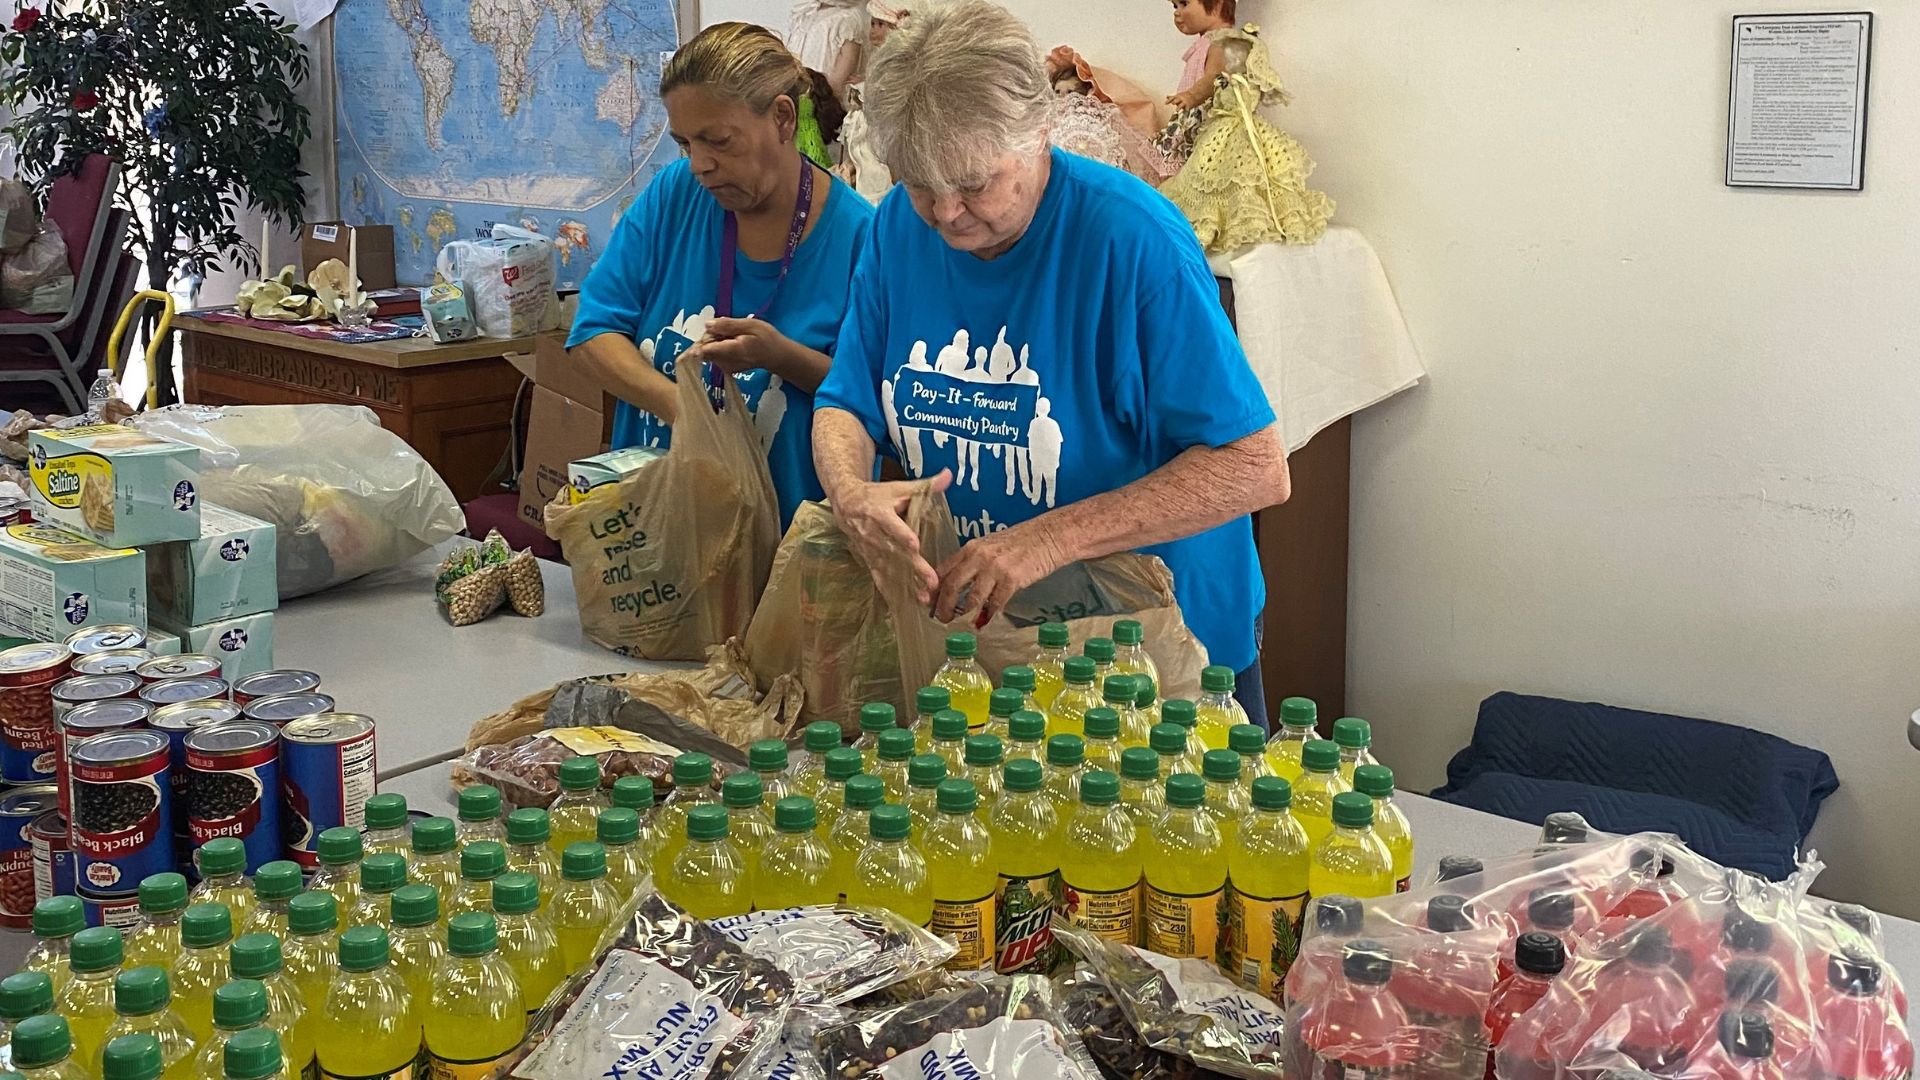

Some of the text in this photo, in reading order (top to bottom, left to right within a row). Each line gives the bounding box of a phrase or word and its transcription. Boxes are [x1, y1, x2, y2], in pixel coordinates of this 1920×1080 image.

[912, 380, 1018, 411] Pay-It-Forward
[904, 405, 1019, 442] Community Pantry
[48, 471, 79, 494] Saltine
[602, 555, 632, 585] and
[610, 580, 682, 618] recycle.
[3, 726, 41, 740] Beans
[21, 741, 44, 749] Red
[78, 831, 144, 852] Black Bea
[204, 822, 243, 839] Black
[0, 860, 33, 872] Kidne
[14, 850, 32, 860] Lig
[962, 930, 978, 940] 230
[1170, 922, 1186, 932] 230
[654, 1001, 692, 1047] NUT
[665, 1004, 719, 1064] FRUIT
[602, 1043, 651, 1080] MIX
[920, 1050, 946, 1080] ND
